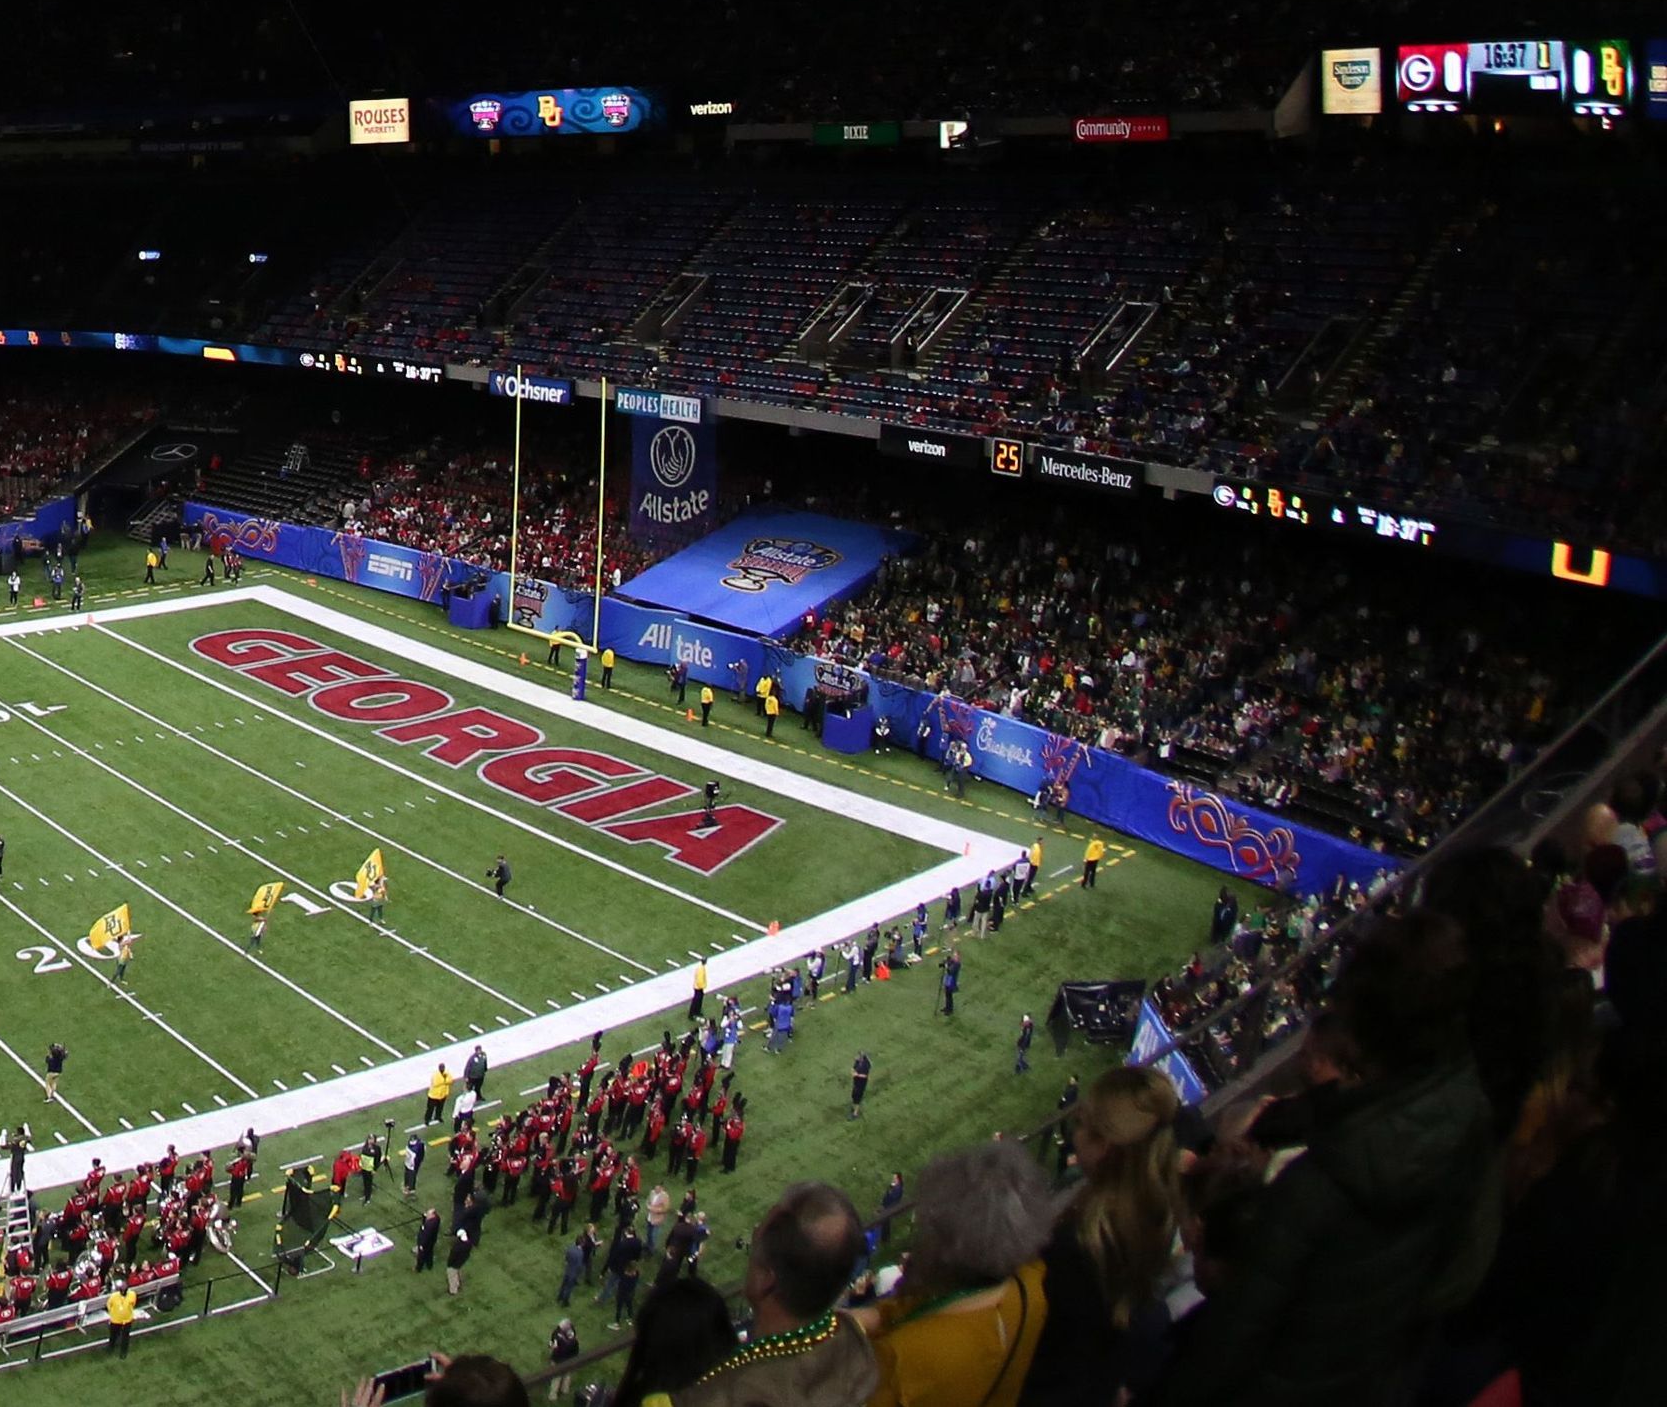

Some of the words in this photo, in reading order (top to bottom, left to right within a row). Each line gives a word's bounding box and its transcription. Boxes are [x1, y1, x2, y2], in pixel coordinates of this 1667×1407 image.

[1485, 43, 1527, 69] 16:37
[354, 108, 406, 126] ROUSES
[690, 102, 732, 116] verizon
[843, 125, 868, 139] DIXIE
[1076, 119, 1131, 140] Community
[617, 393, 659, 412] PEOPLES
[661, 396, 699, 417] HEALTH
[908, 439, 946, 457] verizon
[995, 444, 1021, 471] 25
[1041, 456, 1132, 489] Mercedes-Benz
[639, 489, 710, 524] Allstate
[367, 553, 413, 582] ESPN
[189, 628, 786, 877] GEORGIA
